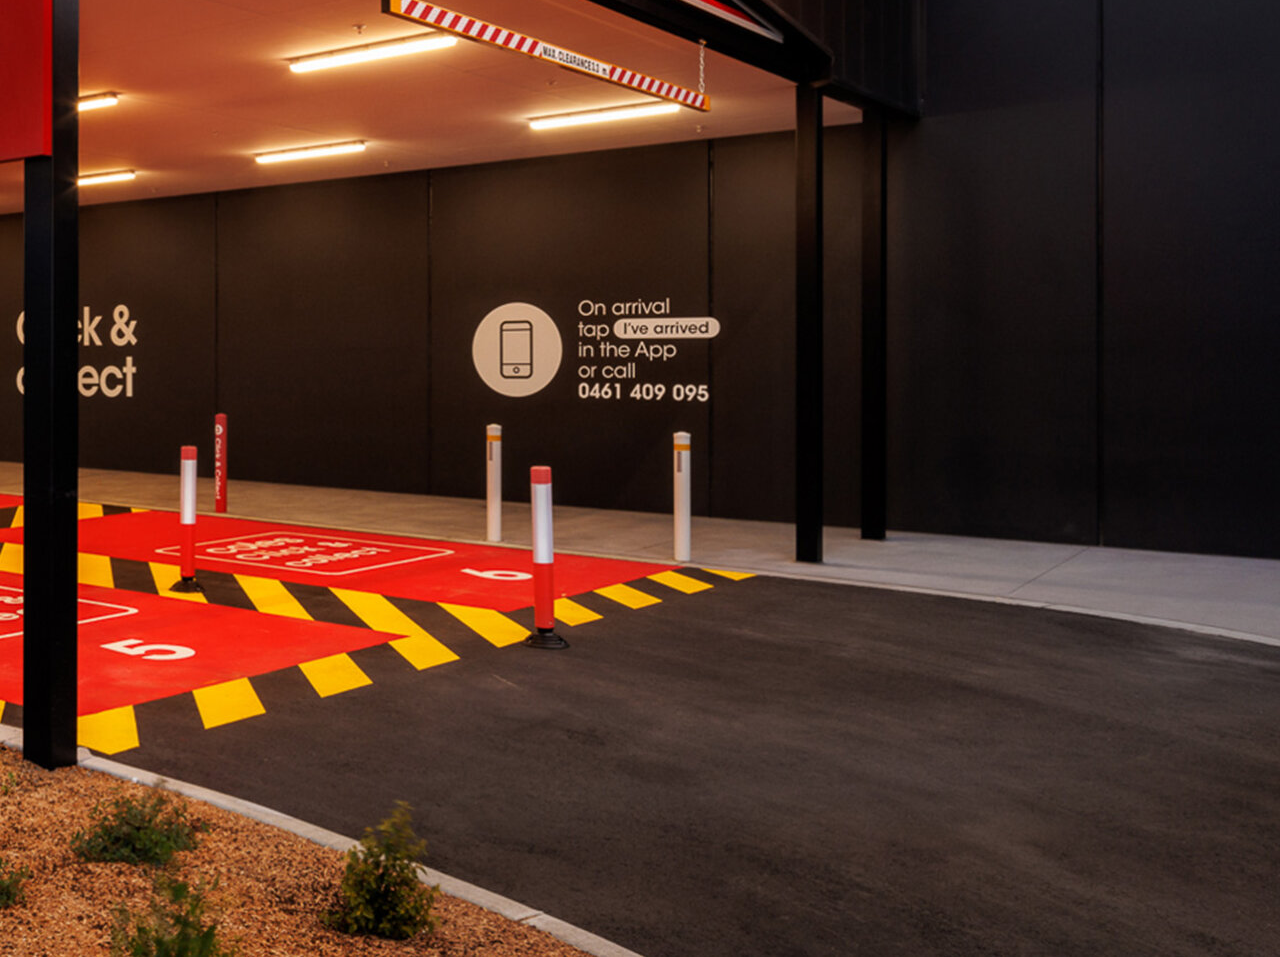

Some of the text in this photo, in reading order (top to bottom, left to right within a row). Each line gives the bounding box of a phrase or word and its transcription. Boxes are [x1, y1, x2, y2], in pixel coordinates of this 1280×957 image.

[577, 297, 670, 316] On arrival
[110, 304, 138, 347] &
[577, 321, 709, 340] tap I've arrived
[577, 340, 677, 361] in the App
[577, 362, 636, 379] or call
[577, 382, 710, 402] 0461 409 095
[459, 568, 534, 581] 6
[99, 638, 197, 661] 5
